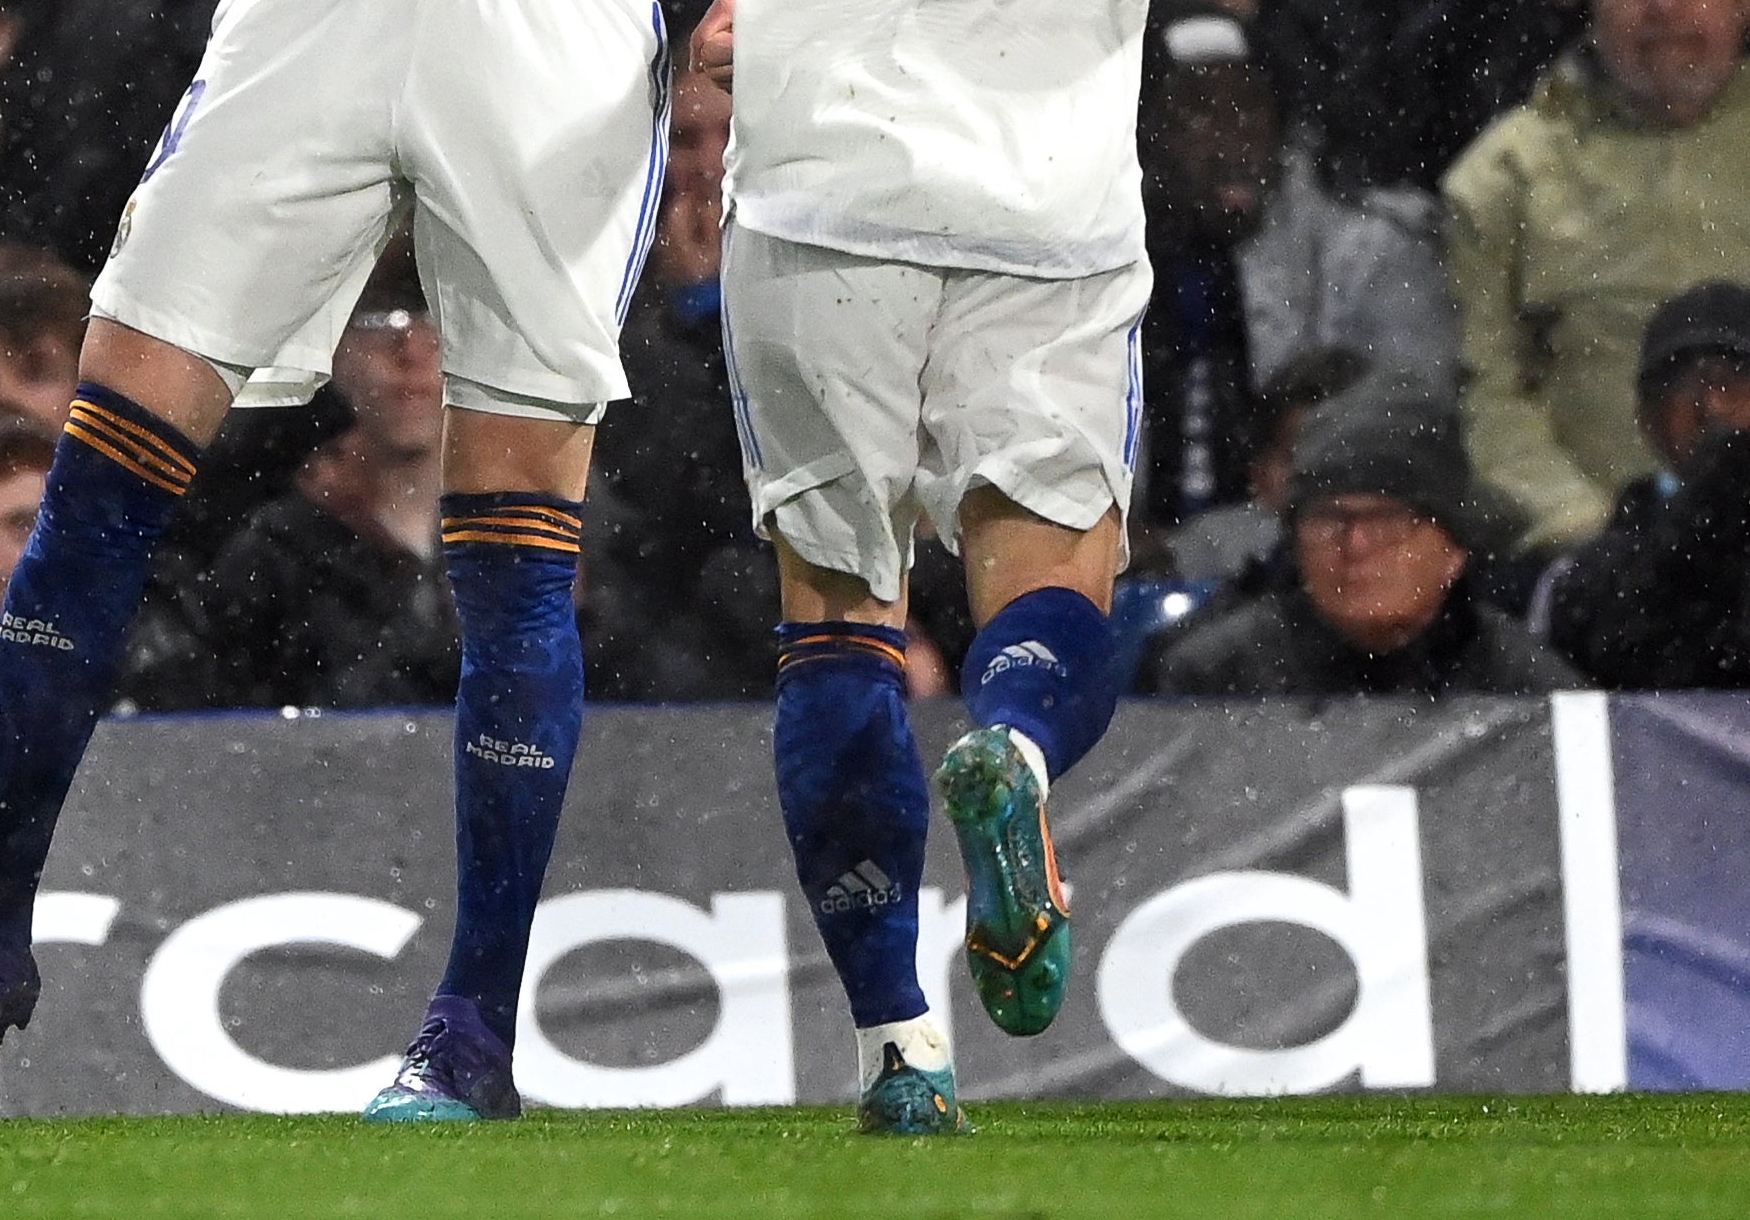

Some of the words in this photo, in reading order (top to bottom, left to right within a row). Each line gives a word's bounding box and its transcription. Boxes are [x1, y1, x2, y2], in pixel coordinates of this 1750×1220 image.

[2, 610, 61, 635] REAL
[466, 741, 555, 769] MADRID
[479, 732, 544, 756] REAL
